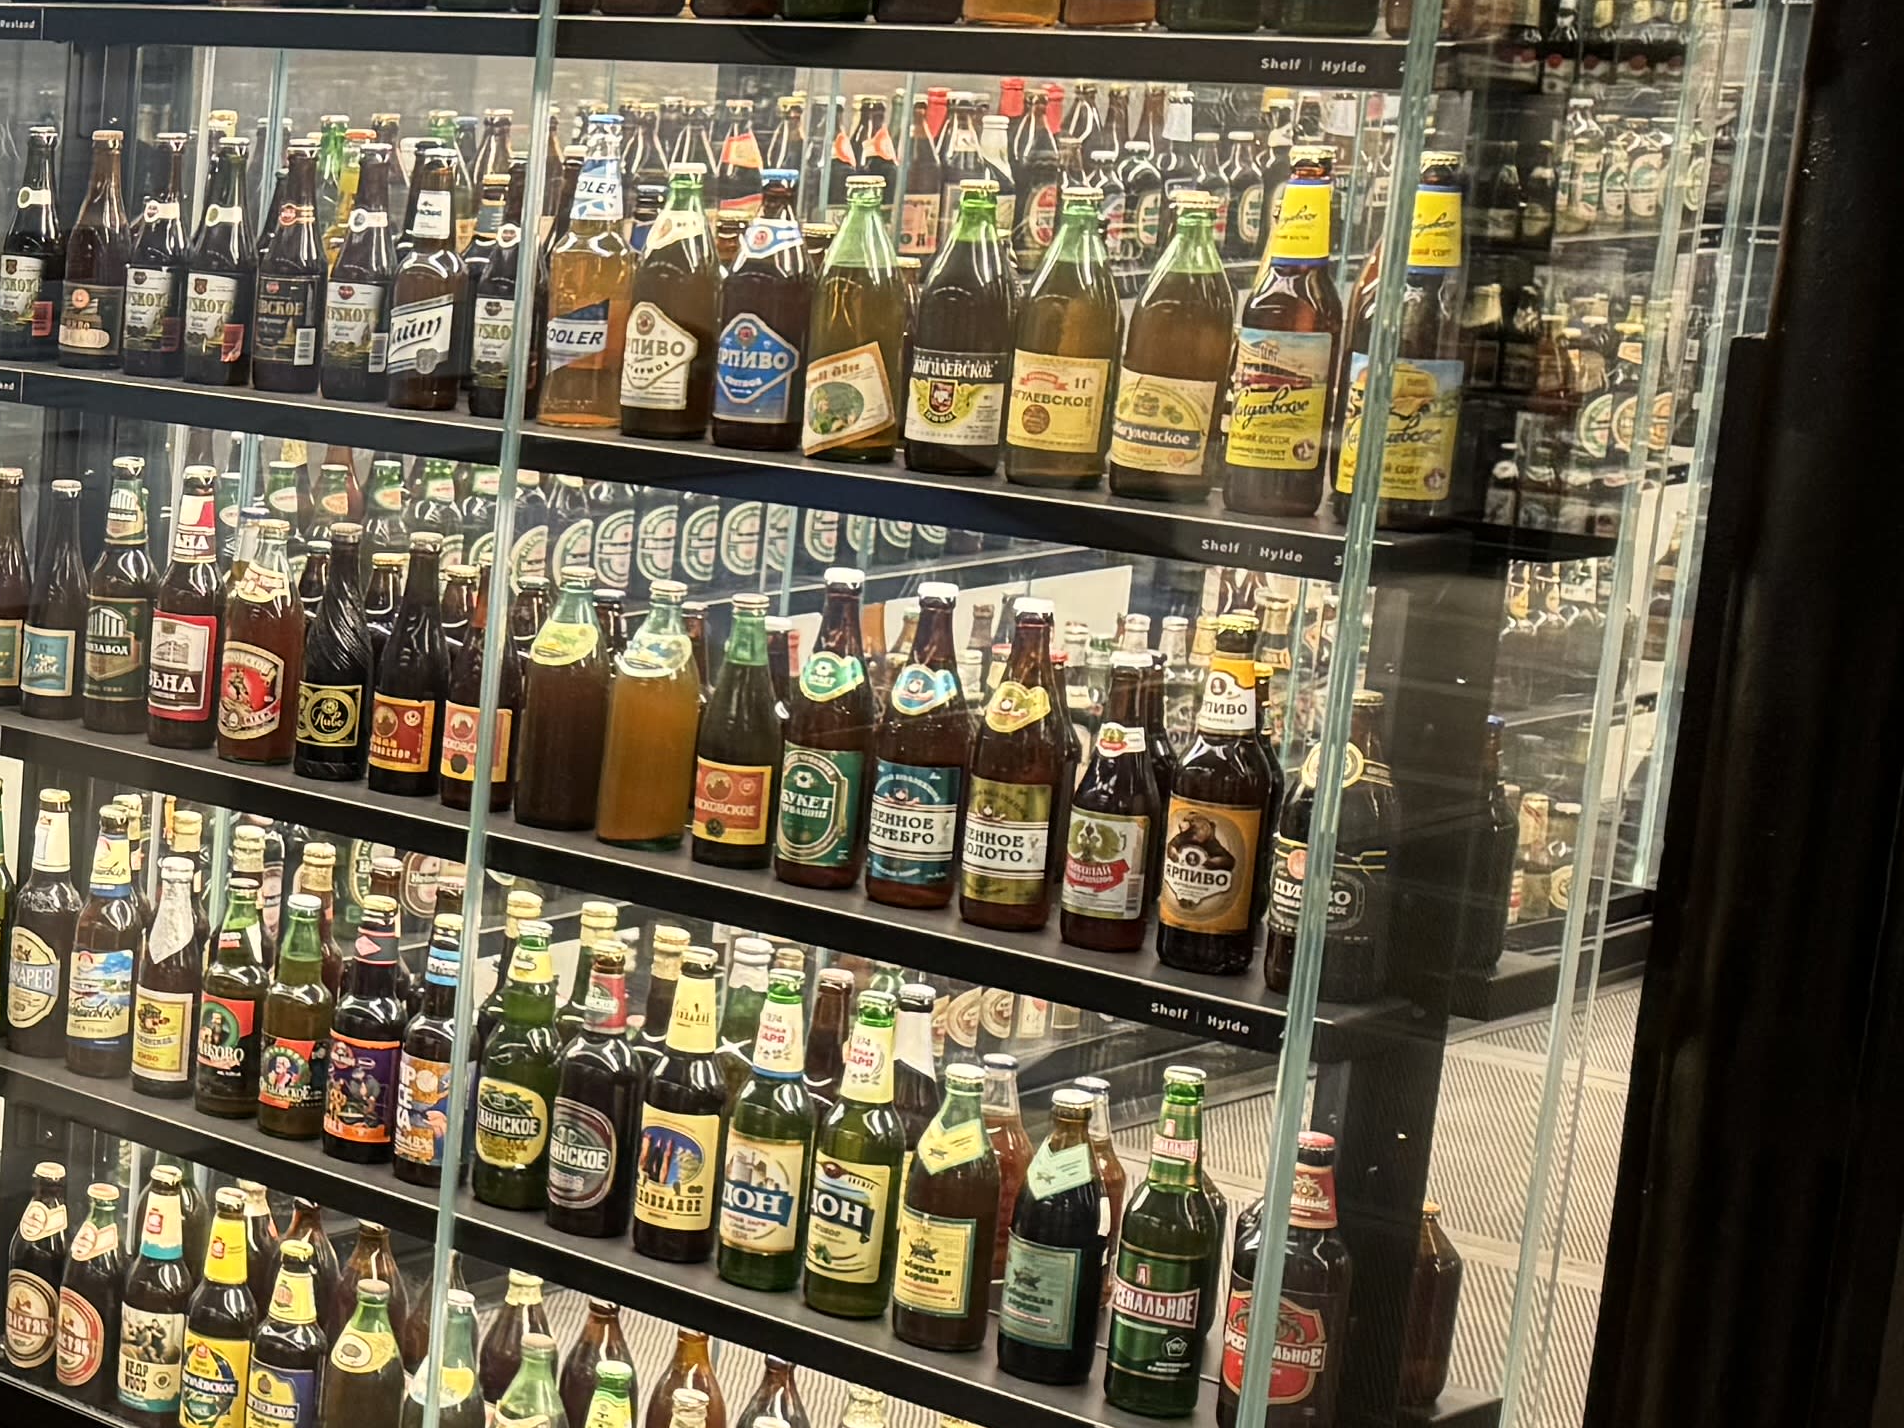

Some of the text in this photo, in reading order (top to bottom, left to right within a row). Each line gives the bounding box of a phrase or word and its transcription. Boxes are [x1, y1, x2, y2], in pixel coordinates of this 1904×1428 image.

[1261, 56, 1367, 76] Shelf Hylde
[547, 327, 605, 348] OOLER
[718, 346, 789, 371] РПИВО
[1201, 537, 1241, 556] Shelf
[1259, 547, 1304, 566] Hylde
[1150, 1002, 1251, 1035] Shelf Hylde
